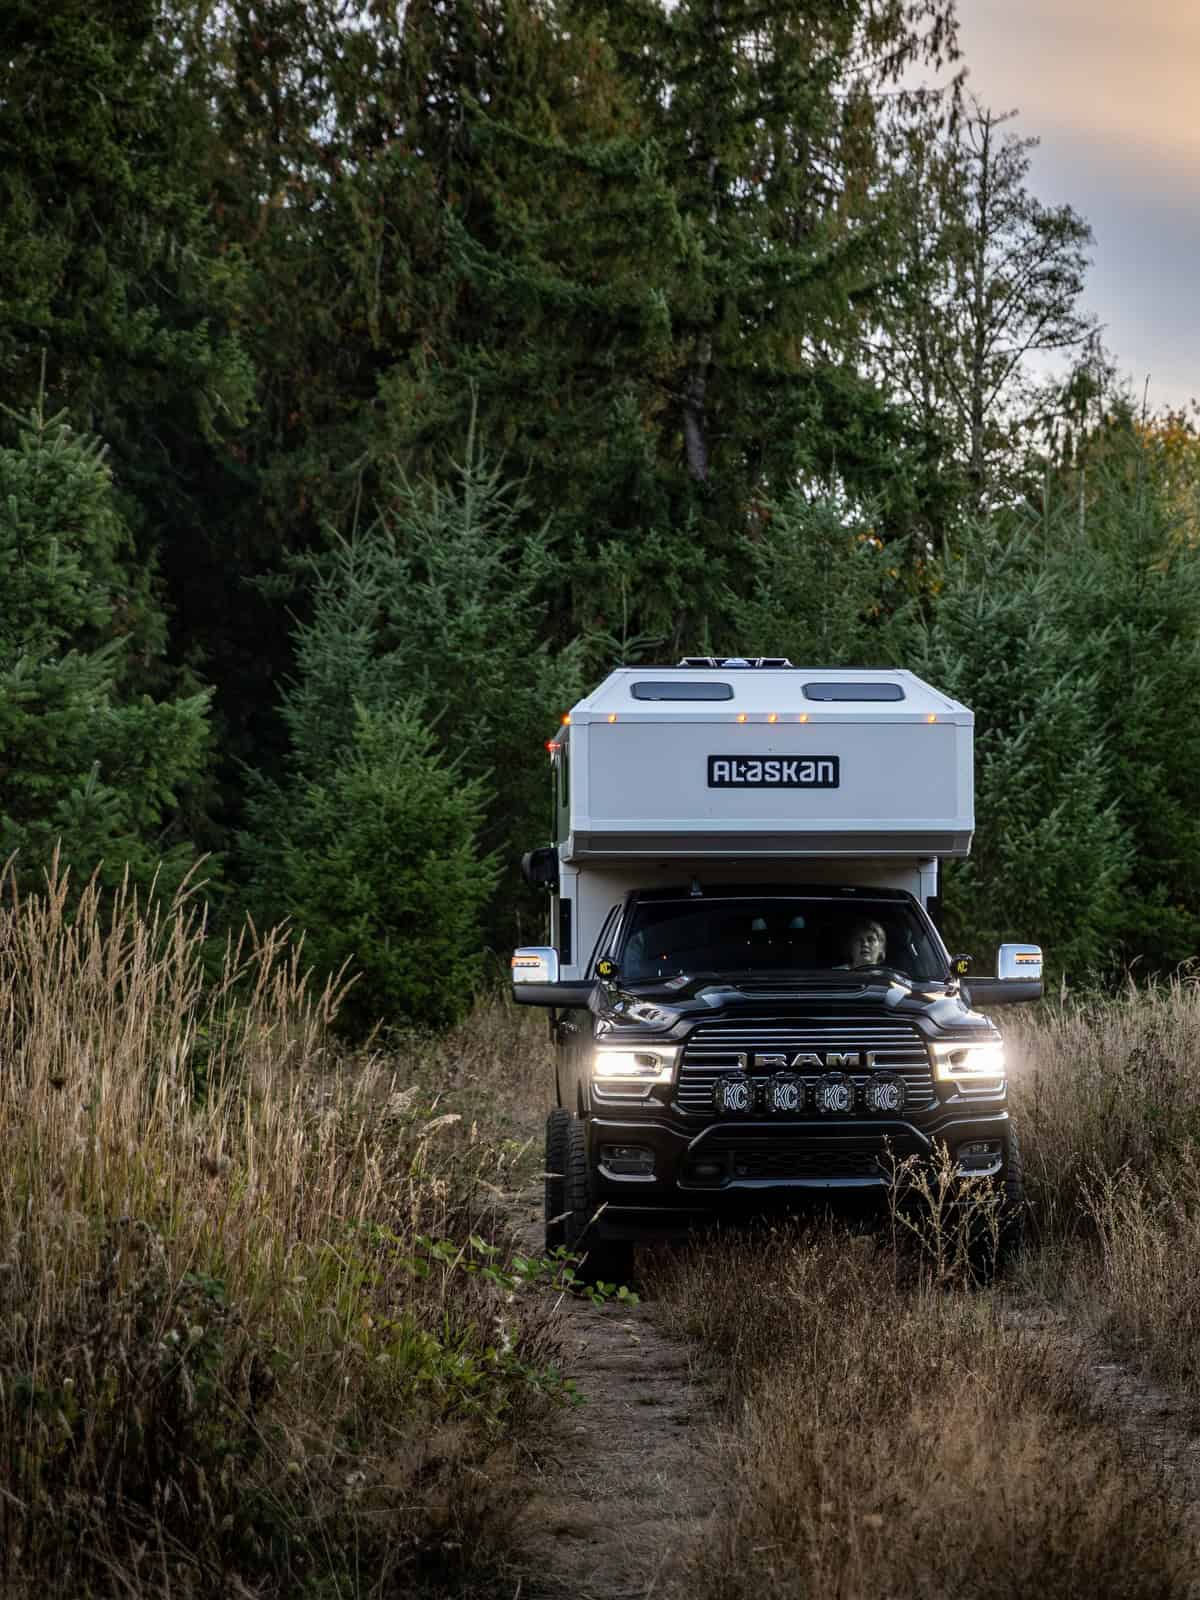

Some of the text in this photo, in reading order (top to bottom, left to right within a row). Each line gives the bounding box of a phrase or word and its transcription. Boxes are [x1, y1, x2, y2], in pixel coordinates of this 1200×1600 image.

[599, 961, 611, 975] KC
[754, 1053, 860, 1067] RAM
[723, 1083, 748, 1111] KC
[773, 1083, 798, 1111] KC
[823, 1083, 848, 1111] KC
[873, 1083, 898, 1111] KC
